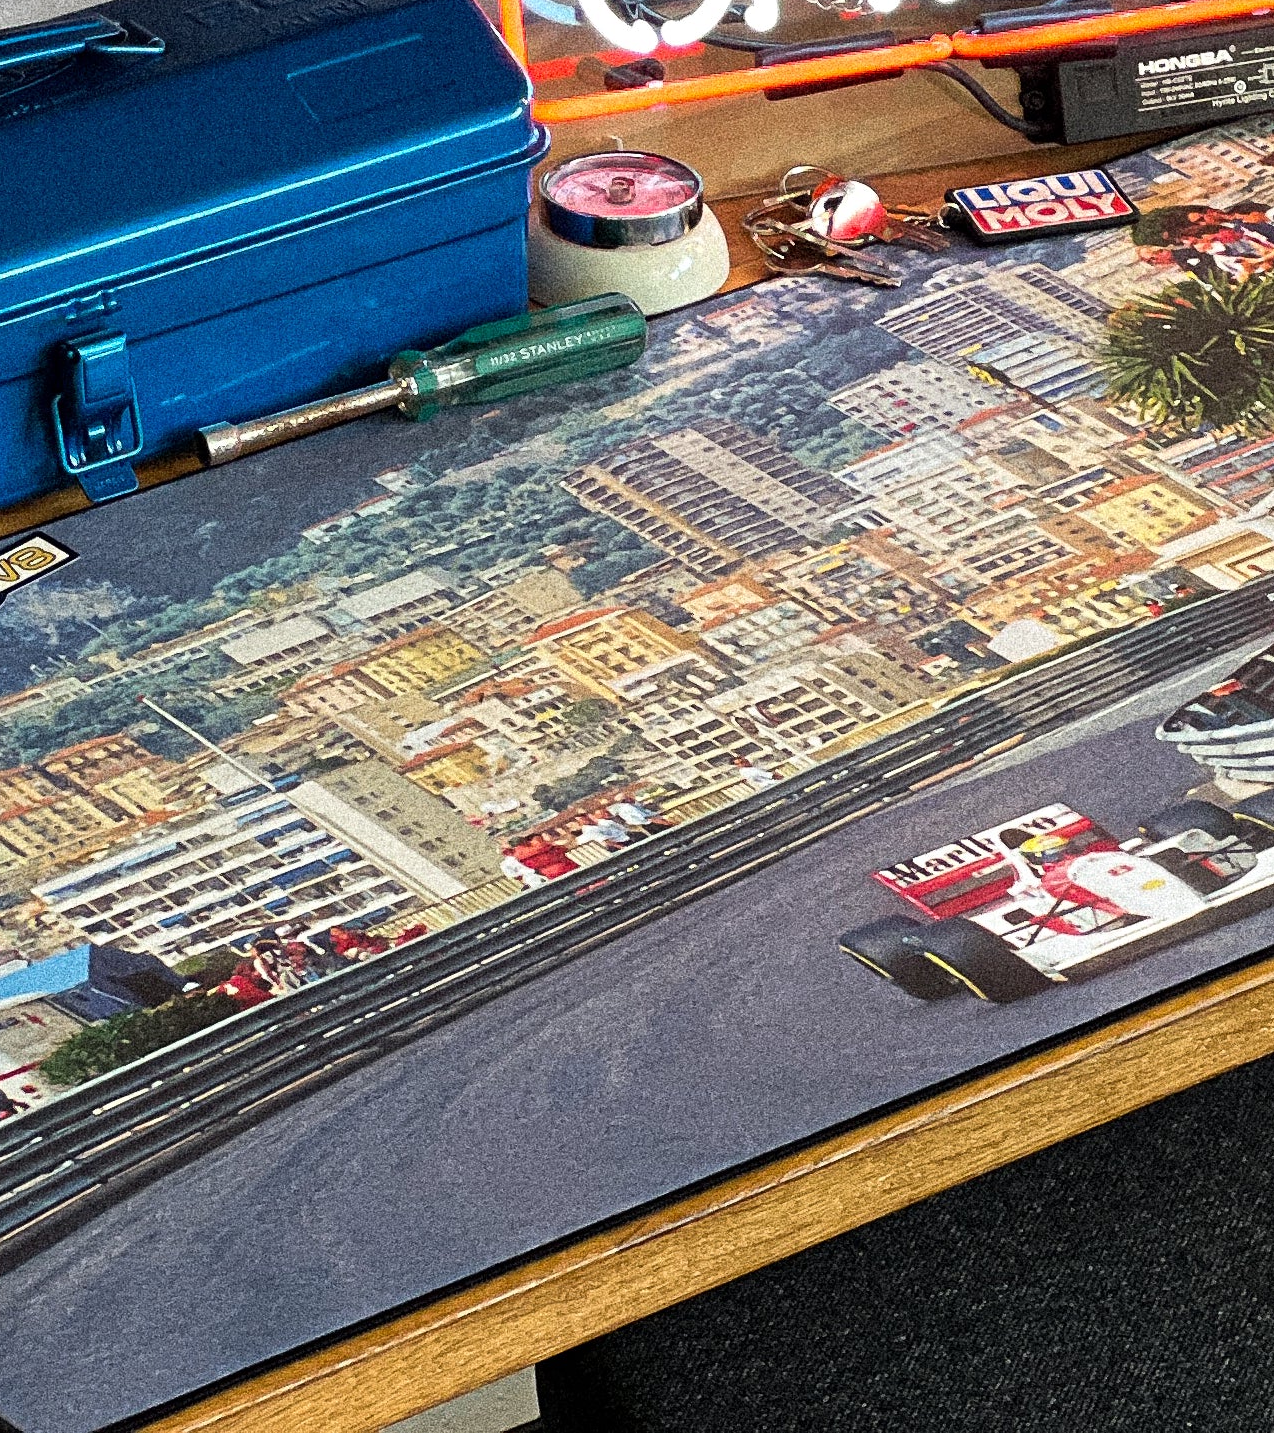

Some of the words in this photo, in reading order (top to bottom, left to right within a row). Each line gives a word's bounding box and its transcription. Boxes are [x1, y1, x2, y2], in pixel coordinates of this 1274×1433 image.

[1138, 49, 1234, 76] HONGBA
[964, 170, 1108, 209] LIQUI
[979, 192, 1116, 231] MOLY
[518, 333, 584, 360] STANLEY
